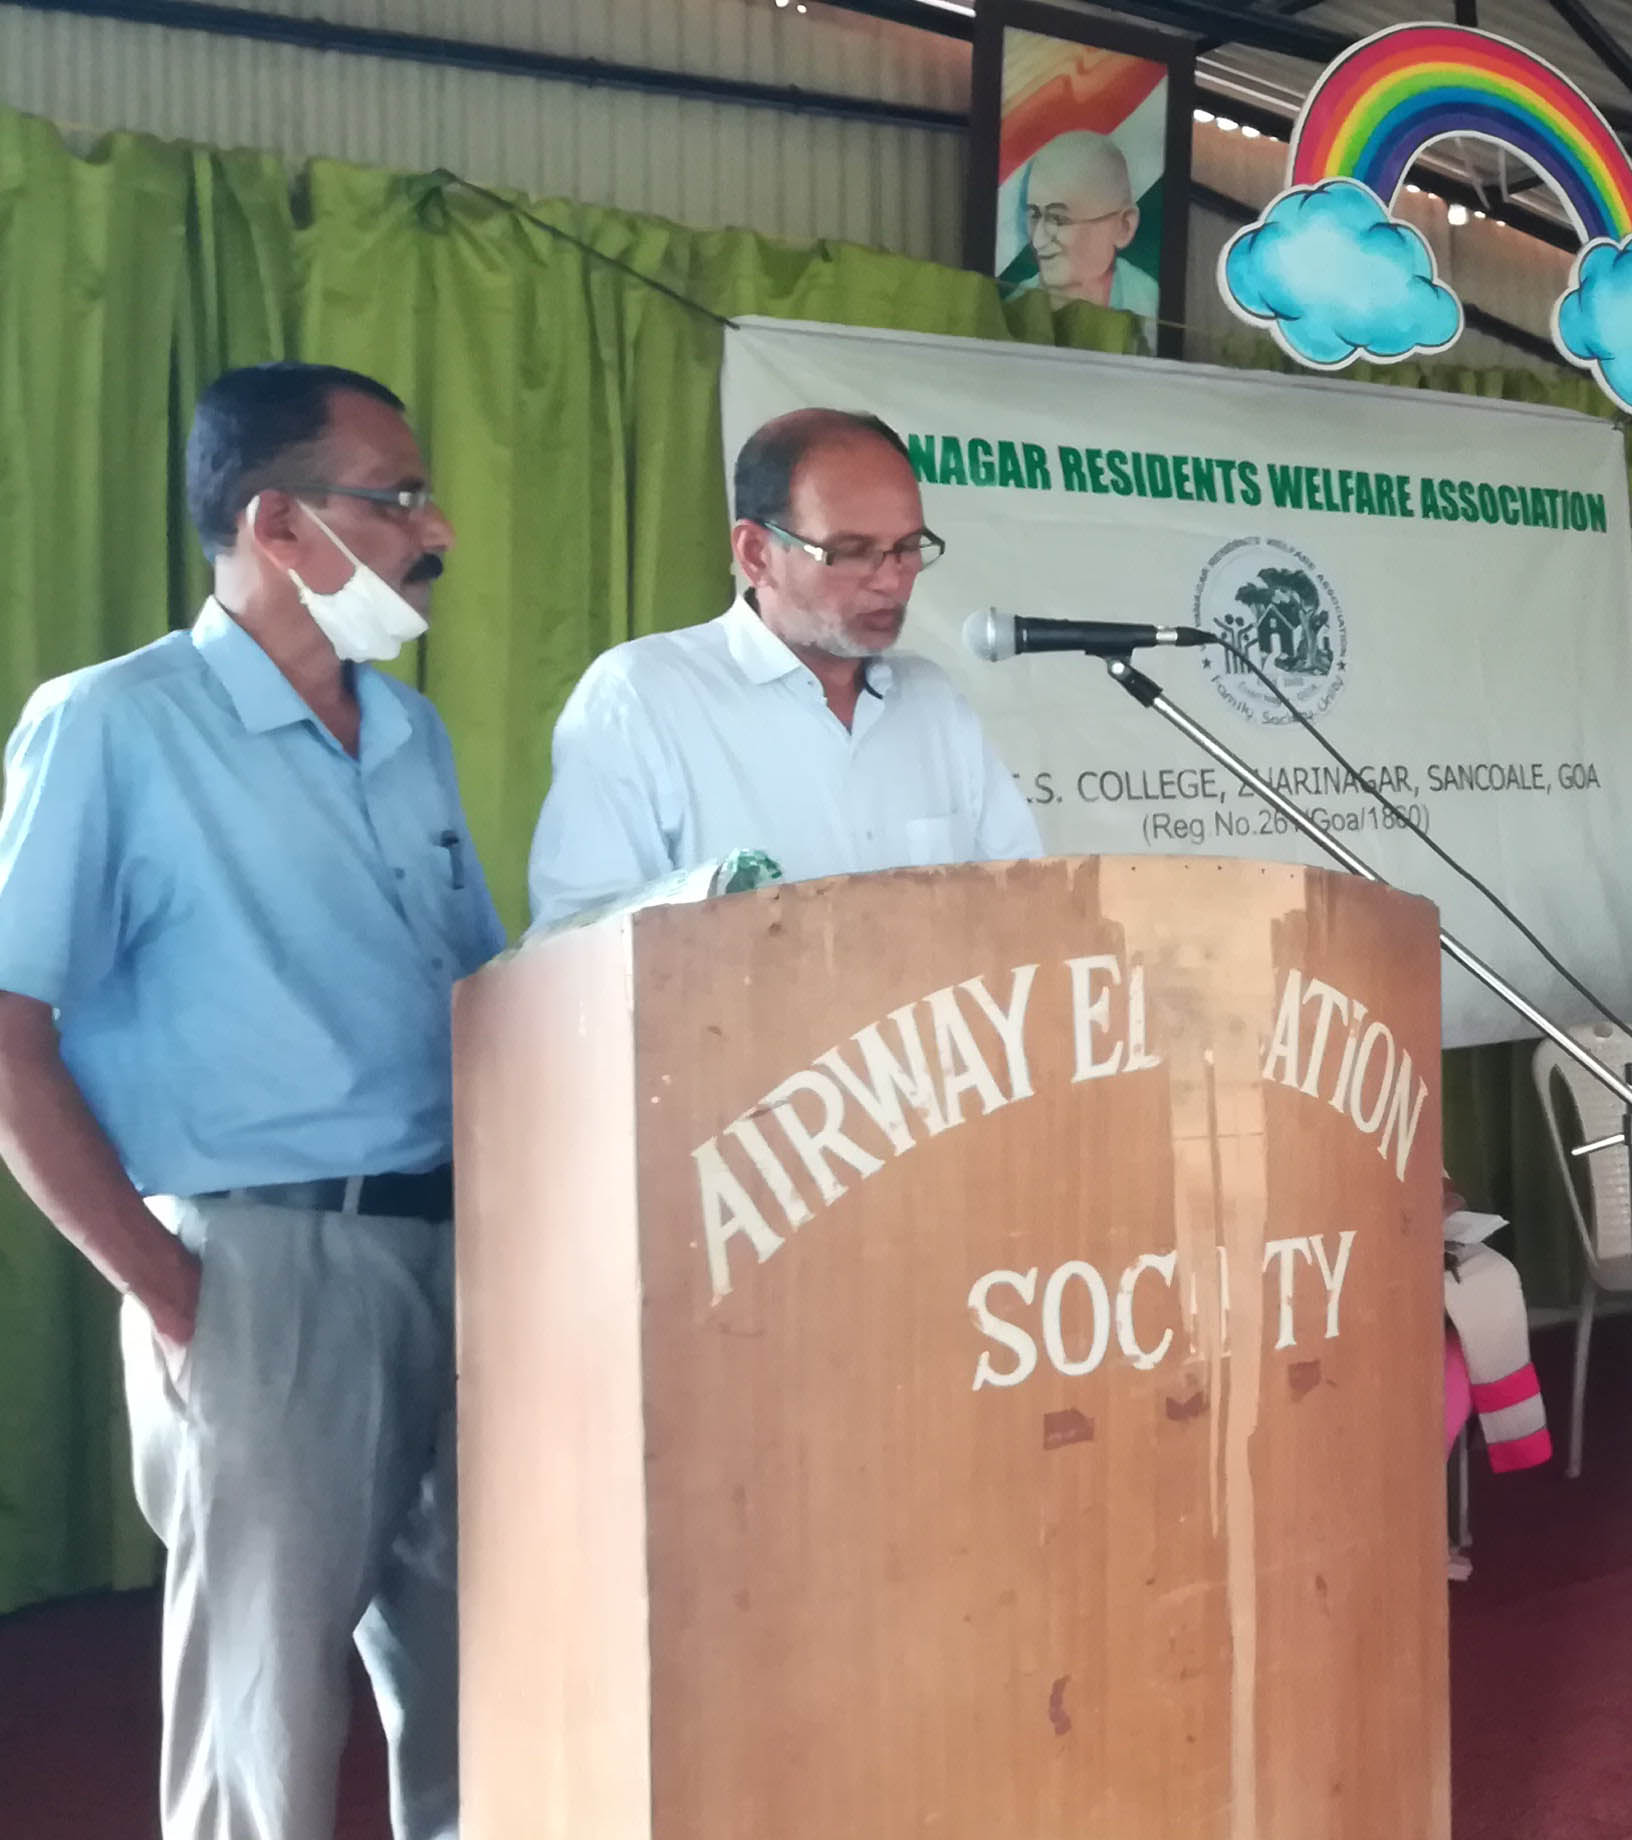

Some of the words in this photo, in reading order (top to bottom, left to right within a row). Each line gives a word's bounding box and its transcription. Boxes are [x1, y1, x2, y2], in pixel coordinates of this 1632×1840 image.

[908, 433, 1052, 491] NAGAR
[1057, 445, 1262, 507] RESIDENTS
[1266, 463, 1415, 518] WELFARE
[1420, 477, 1607, 534] ASSOCIATION
[1076, 768, 1227, 804] COLLEGE,
[1426, 762, 1552, 796] SANCOALE,
[1557, 762, 1601, 789] GOA
[1142, 811, 1205, 848] (Reg
[1214, 802, 1431, 838] No.26/Goa/1860)
[690, 962, 1041, 1308] AIRWAY
[1064, 953, 1429, 1183] ELATION
[967, 1229, 1358, 1392] SOCTY
